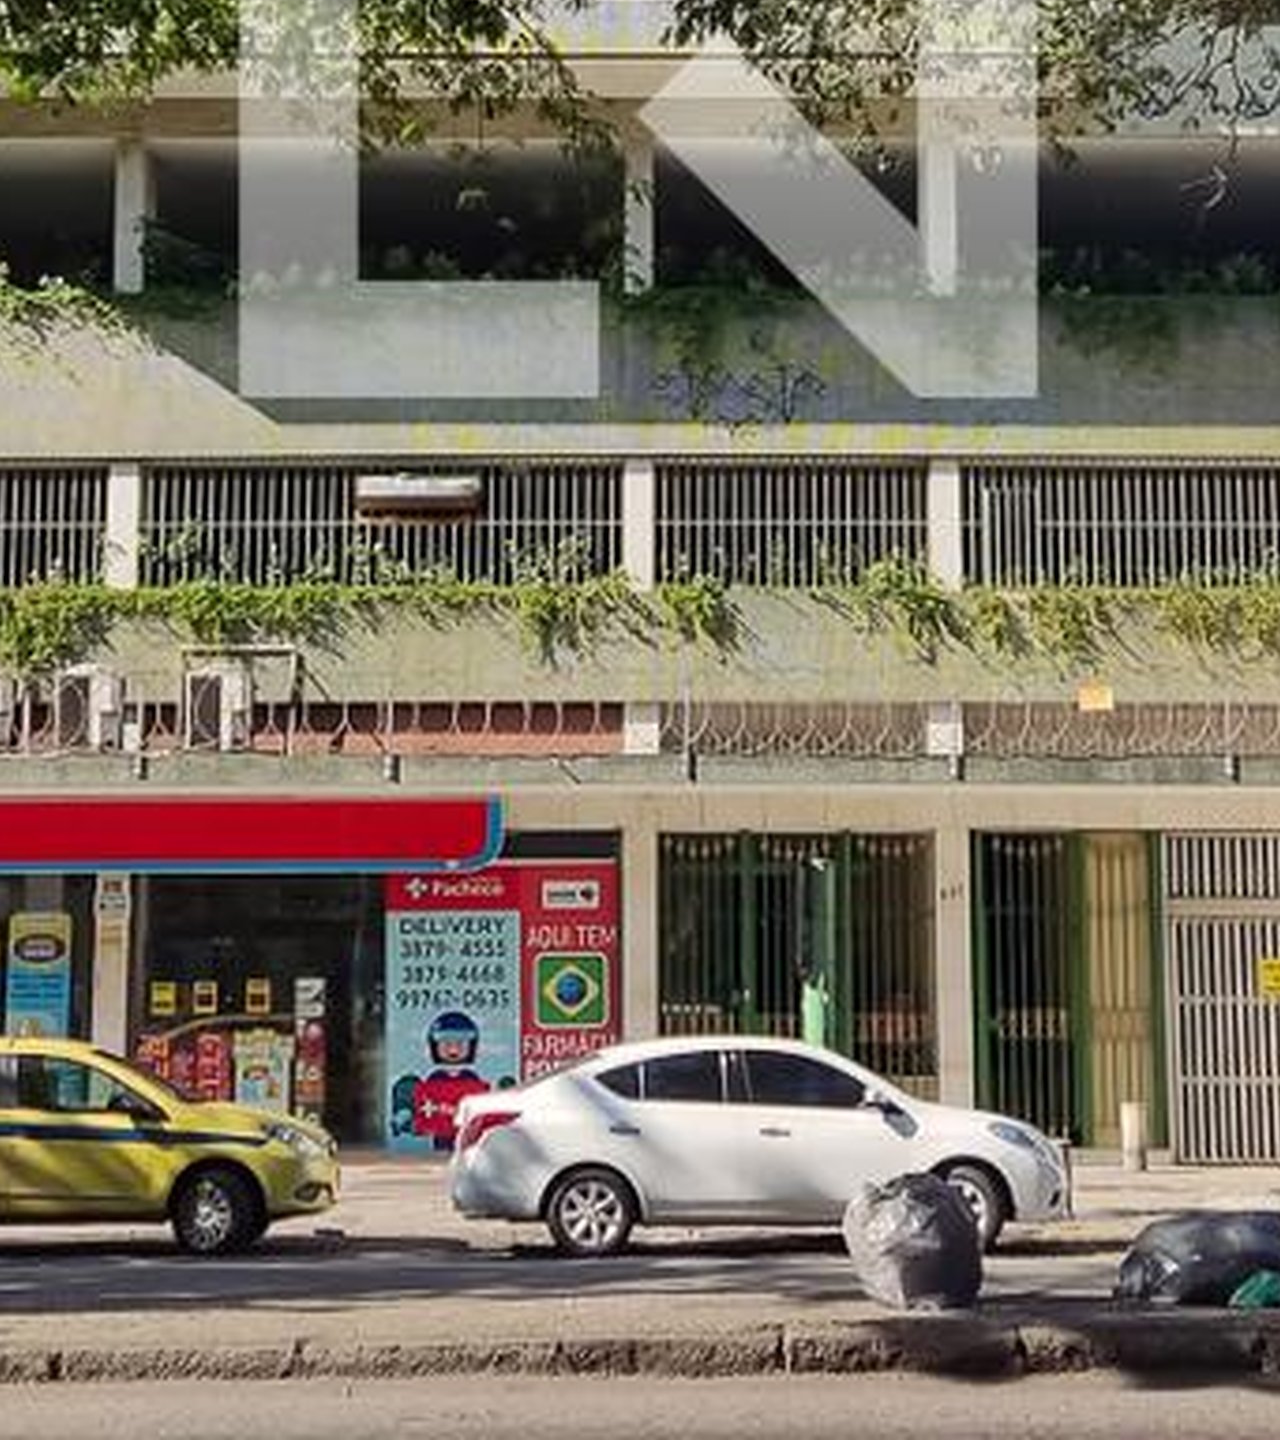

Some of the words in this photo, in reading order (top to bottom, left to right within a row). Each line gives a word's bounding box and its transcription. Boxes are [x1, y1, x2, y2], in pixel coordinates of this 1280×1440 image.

[399, 917, 507, 936] DELIVERY
[526, 924, 570, 949] AQUI
[576, 924, 616, 947] TEM
